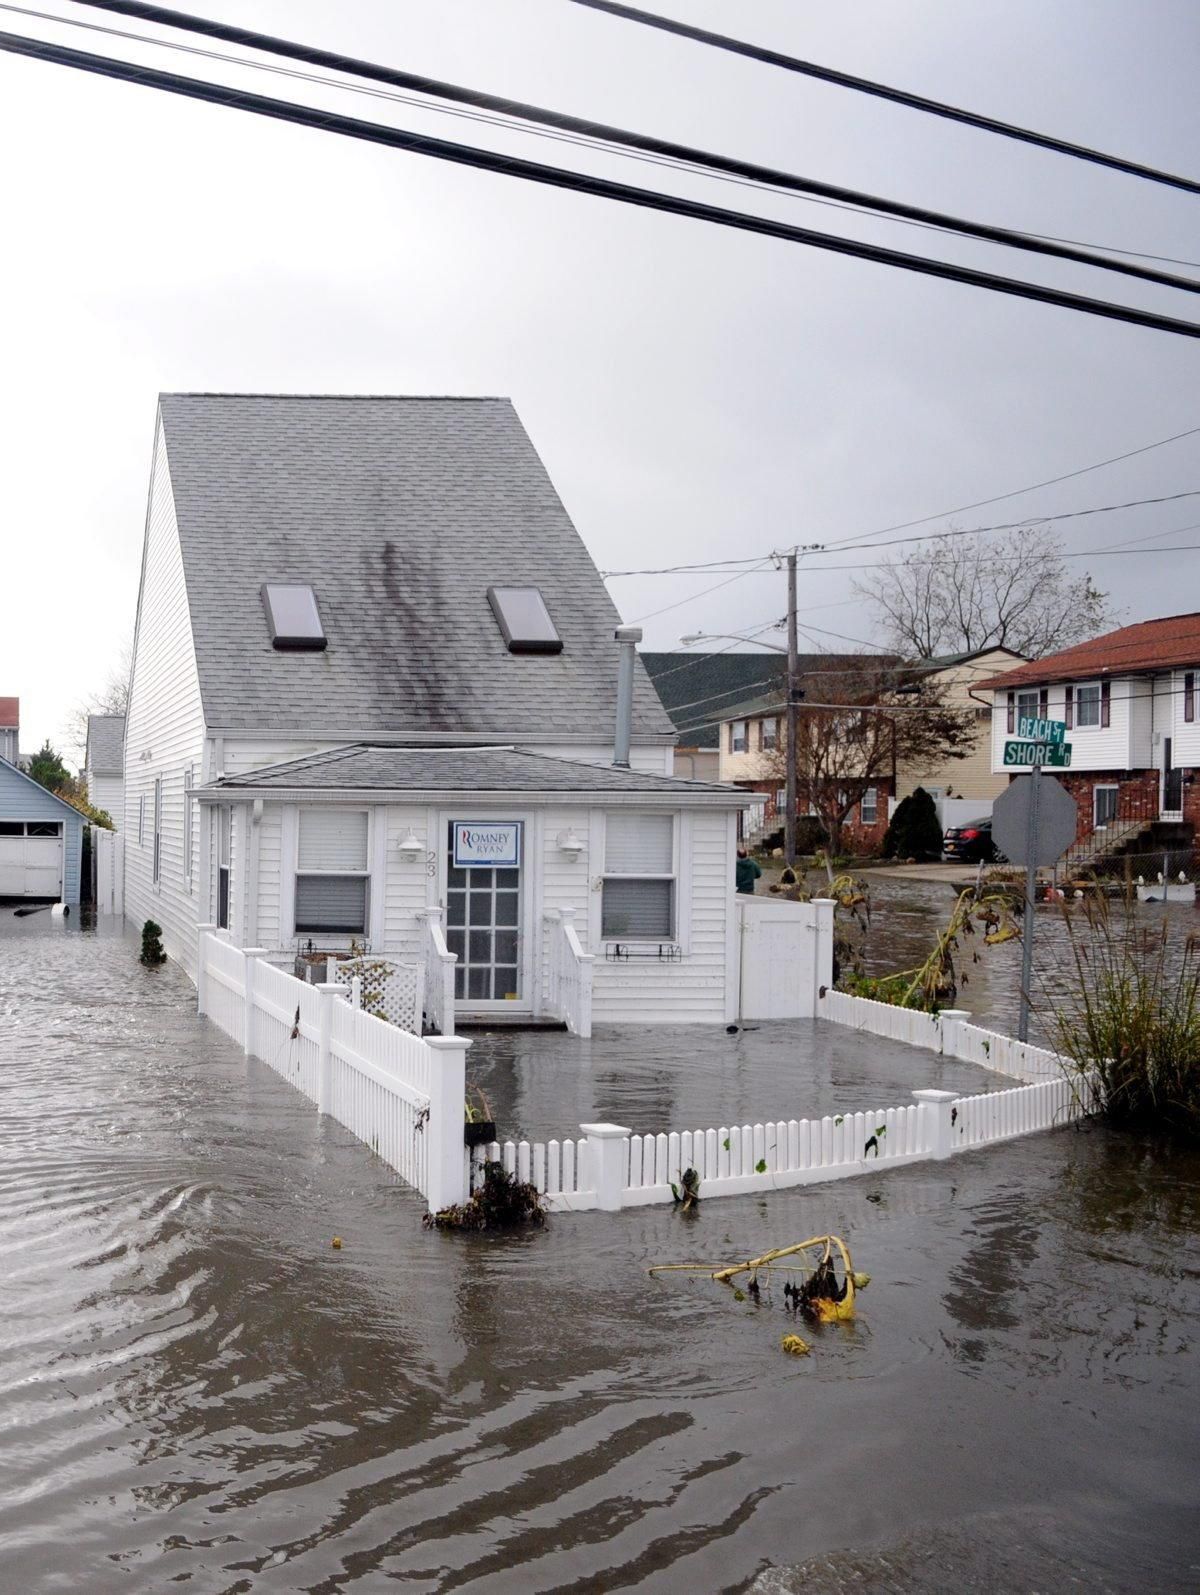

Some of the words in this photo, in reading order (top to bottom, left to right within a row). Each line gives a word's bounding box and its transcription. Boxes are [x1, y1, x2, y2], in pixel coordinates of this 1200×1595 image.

[1020, 717, 1052, 741] BEACH
[1053, 722, 1061, 742] ST
[1006, 743, 1054, 765] SHORE
[1058, 743, 1071, 766] RD
[462, 830, 509, 848] ROMNEY
[477, 845, 503, 853] RYAN
[427, 851, 436, 877] 23
